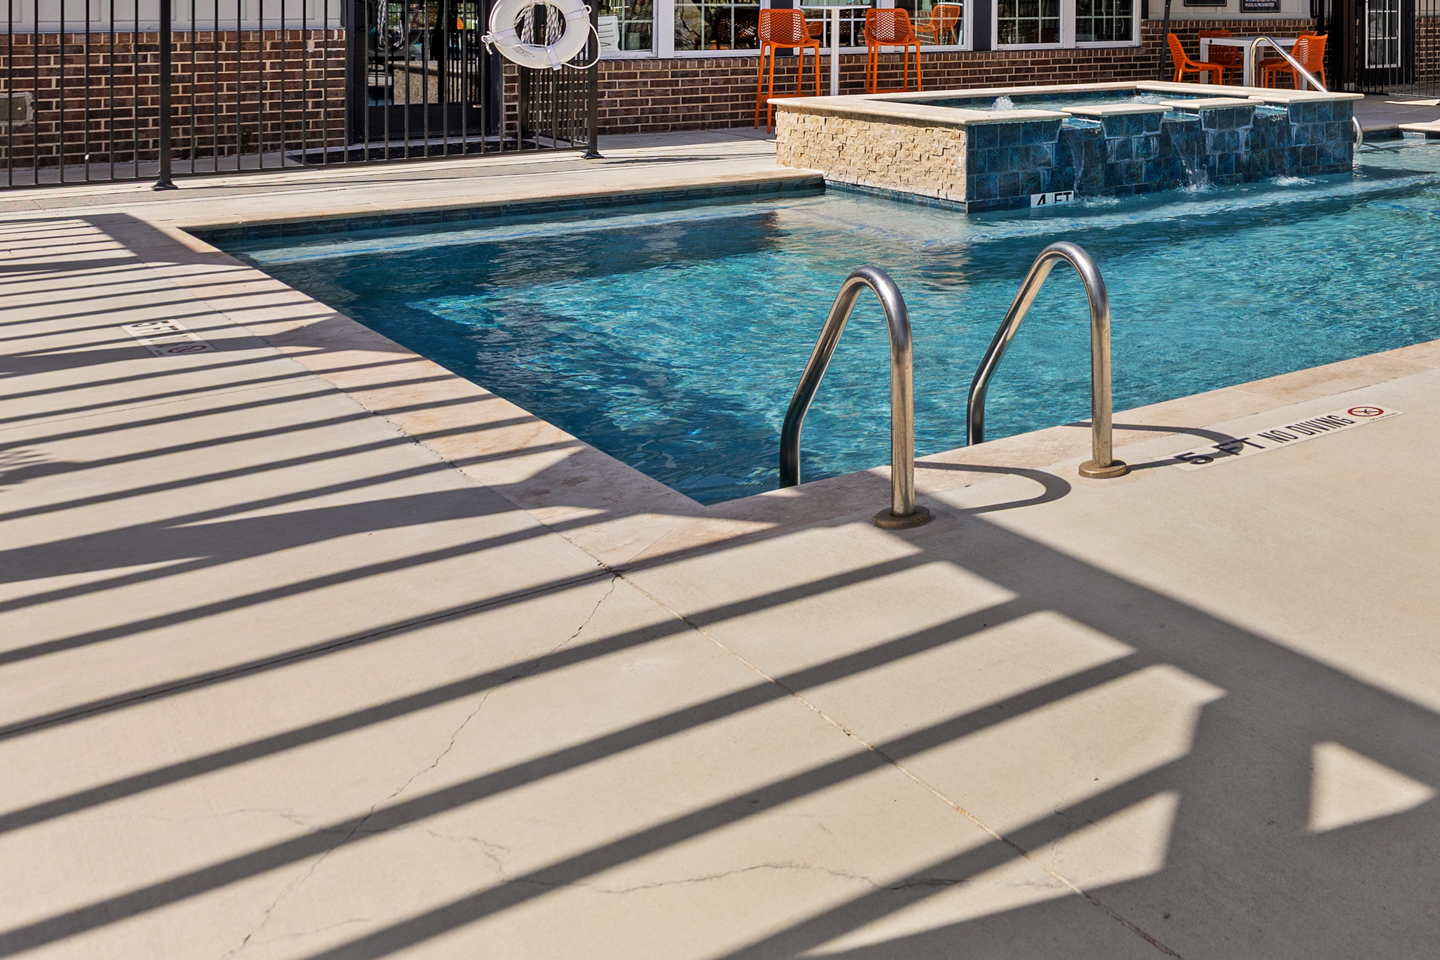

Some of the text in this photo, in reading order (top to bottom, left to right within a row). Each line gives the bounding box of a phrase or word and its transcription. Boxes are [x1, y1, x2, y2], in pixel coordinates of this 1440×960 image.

[1037, 194, 1047, 206] 4
[1173, 451, 1214, 465] 5
[1212, 437, 1265, 456] FT
[1256, 429, 1299, 444] NO
[1284, 415, 1357, 436] DIVING
